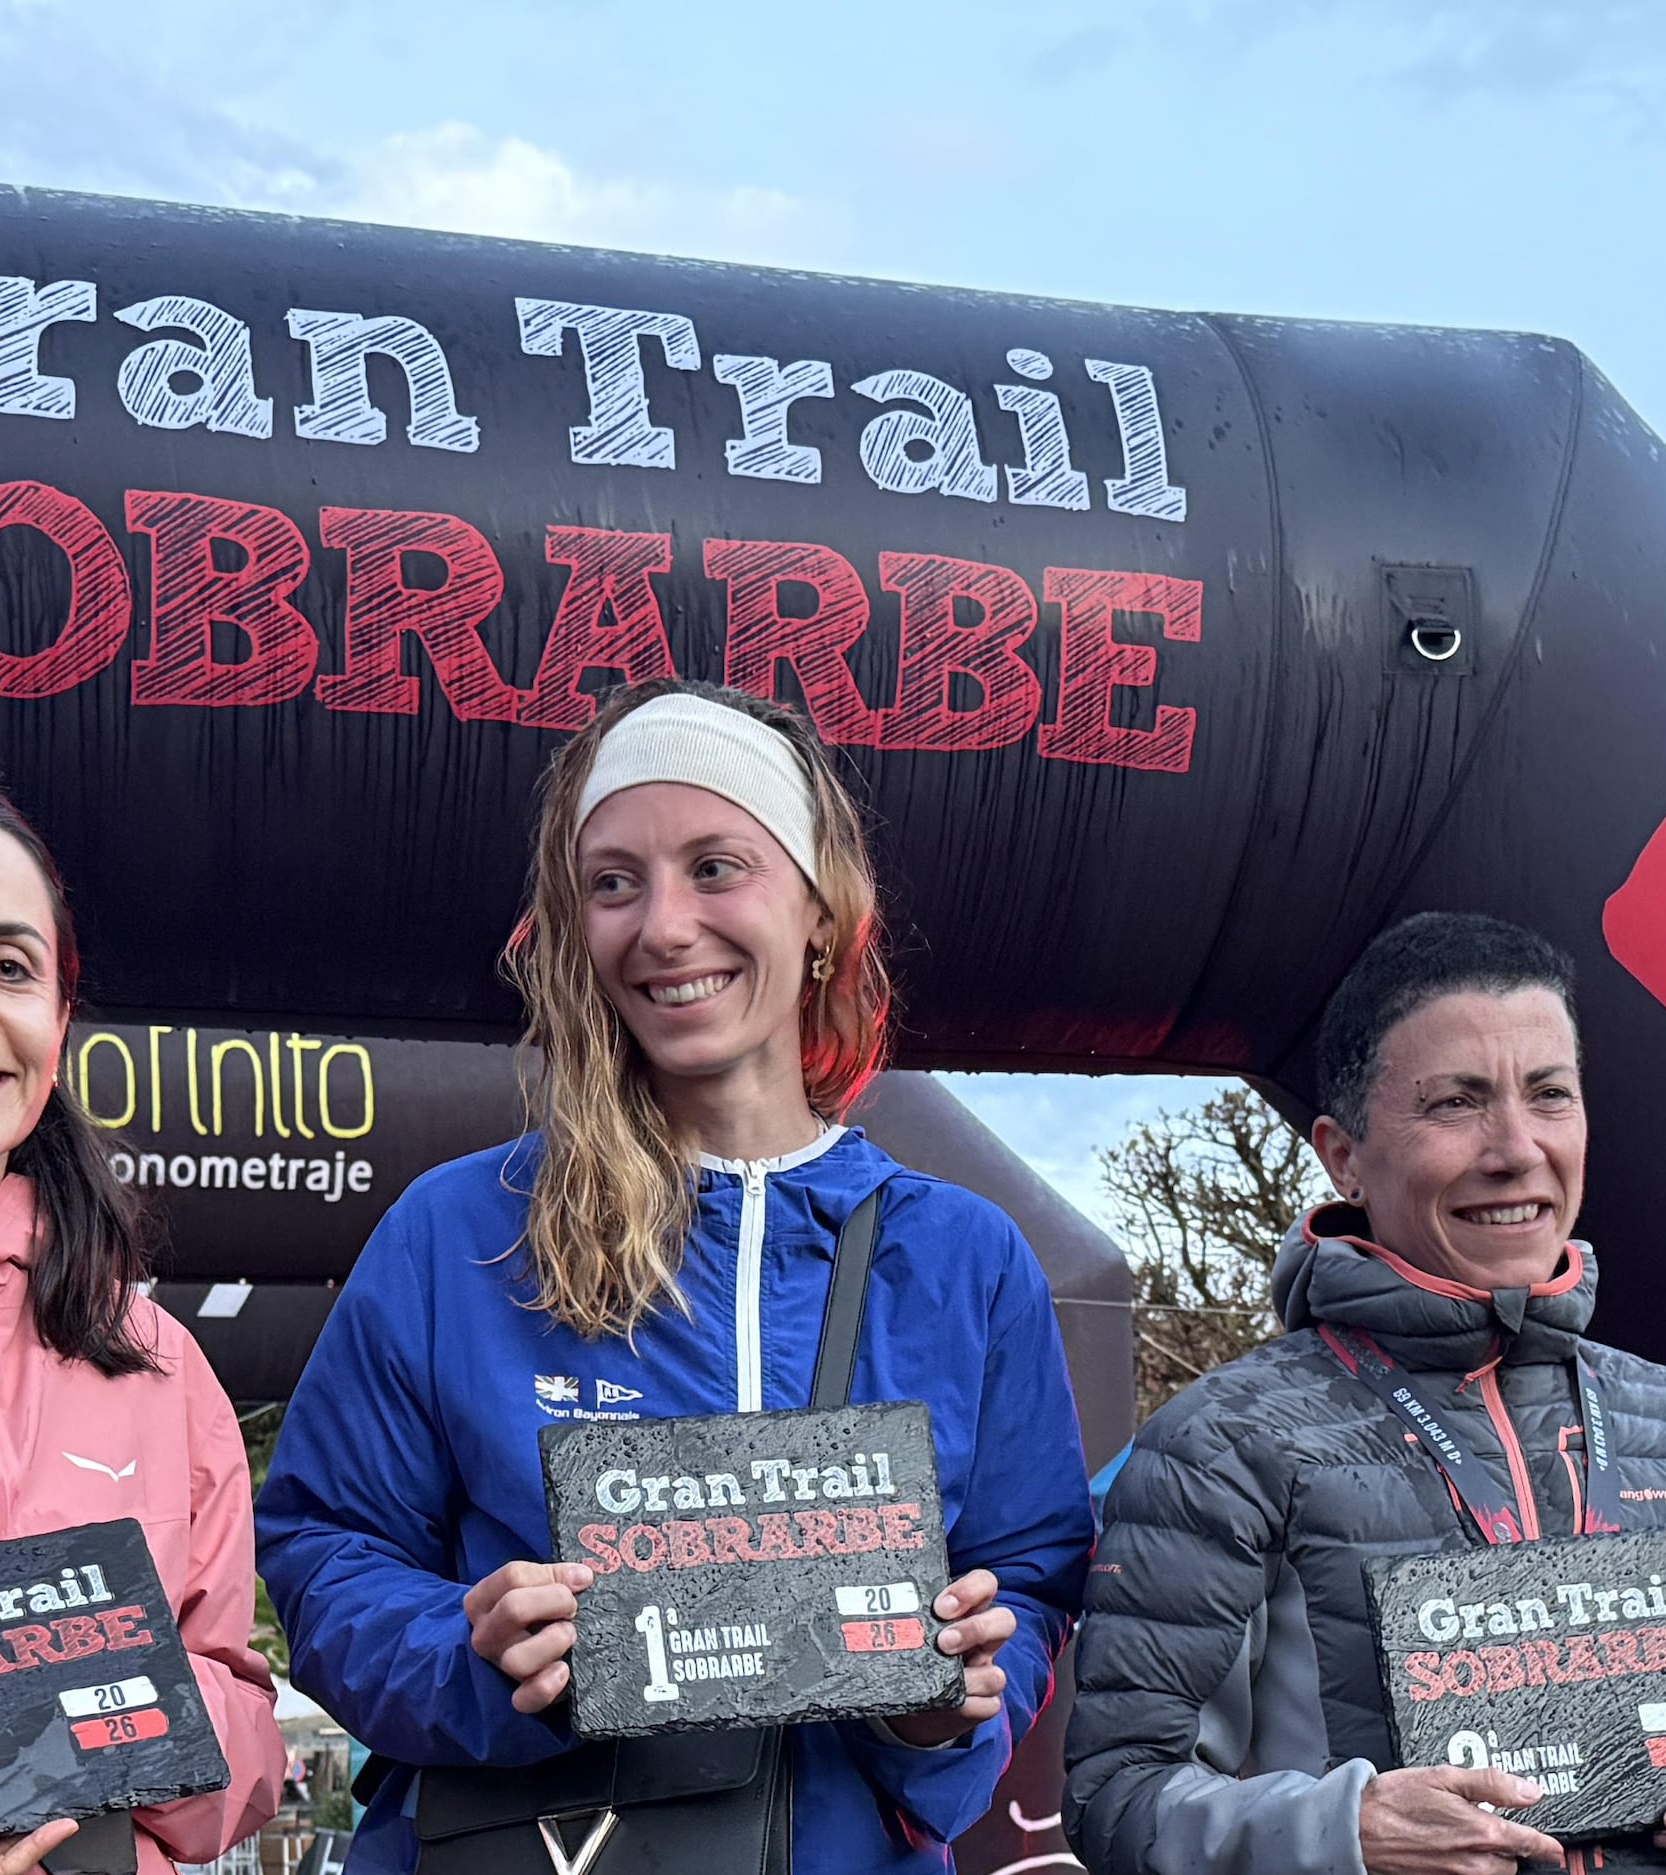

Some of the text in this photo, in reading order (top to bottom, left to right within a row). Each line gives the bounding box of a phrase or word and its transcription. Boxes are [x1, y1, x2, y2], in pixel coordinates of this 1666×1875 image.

[515, 294, 1190, 524] Trail
[1403, 1399, 1425, 1417] KM
[595, 1453, 895, 1514] Gran Trail
[577, 1503, 925, 1575] SOBRARBE
[865, 1587, 891, 1612] 20
[870, 1622, 897, 1648] 26
[1417, 1597, 1554, 1643] Gran
[669, 1623, 772, 1654] GRAN TRAIL
[672, 1652, 766, 1683] SOBRARBE
[94, 1684, 127, 1712] 20
[103, 1715, 138, 1742] 26
[1491, 1742, 1584, 1773] GRAN TRAIL
